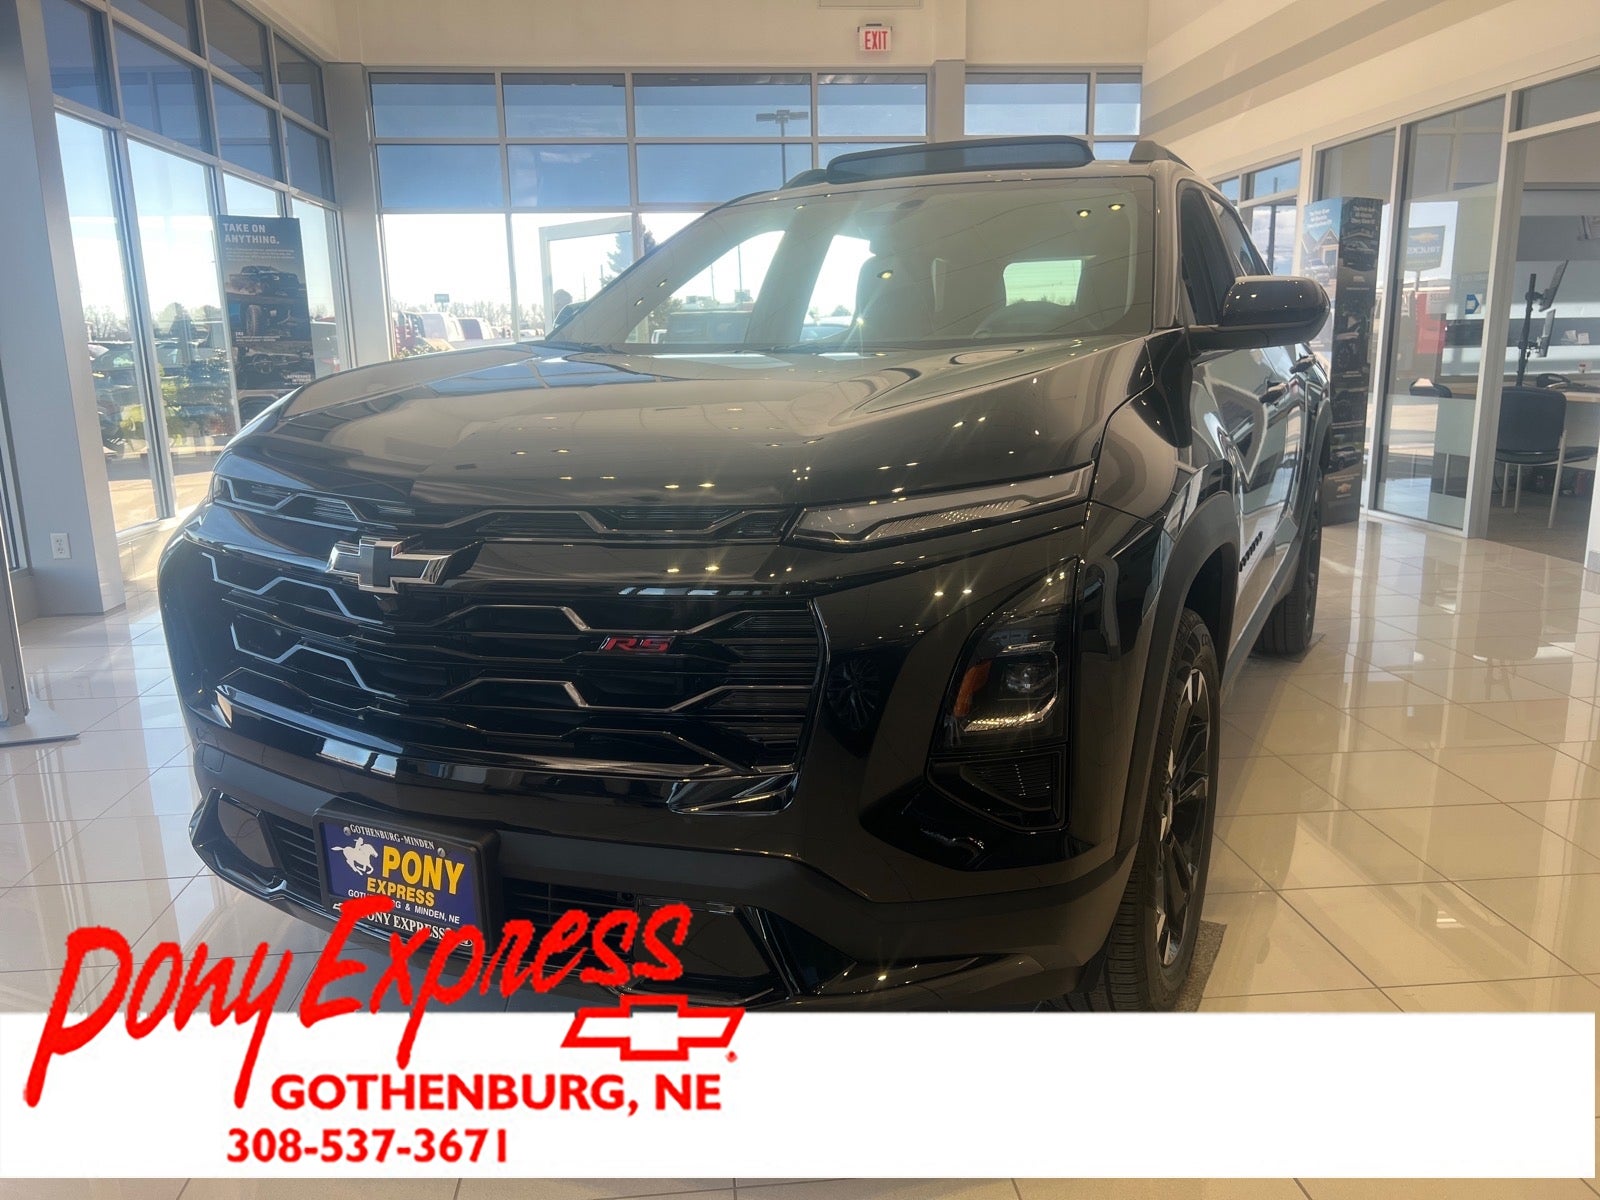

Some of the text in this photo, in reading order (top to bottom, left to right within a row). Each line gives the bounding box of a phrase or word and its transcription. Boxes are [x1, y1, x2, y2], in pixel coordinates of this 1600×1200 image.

[864, 30, 888, 50] EXIT
[223, 223, 266, 233] TAKE ON
[224, 234, 280, 245] ANYTHING.
[601, 635, 671, 653] RS
[382, 845, 465, 895] PONY
[366, 877, 435, 907] EXPRESS
[360, 911, 391, 926] ONY
[405, 903, 460, 924] & MINDEN, NE
